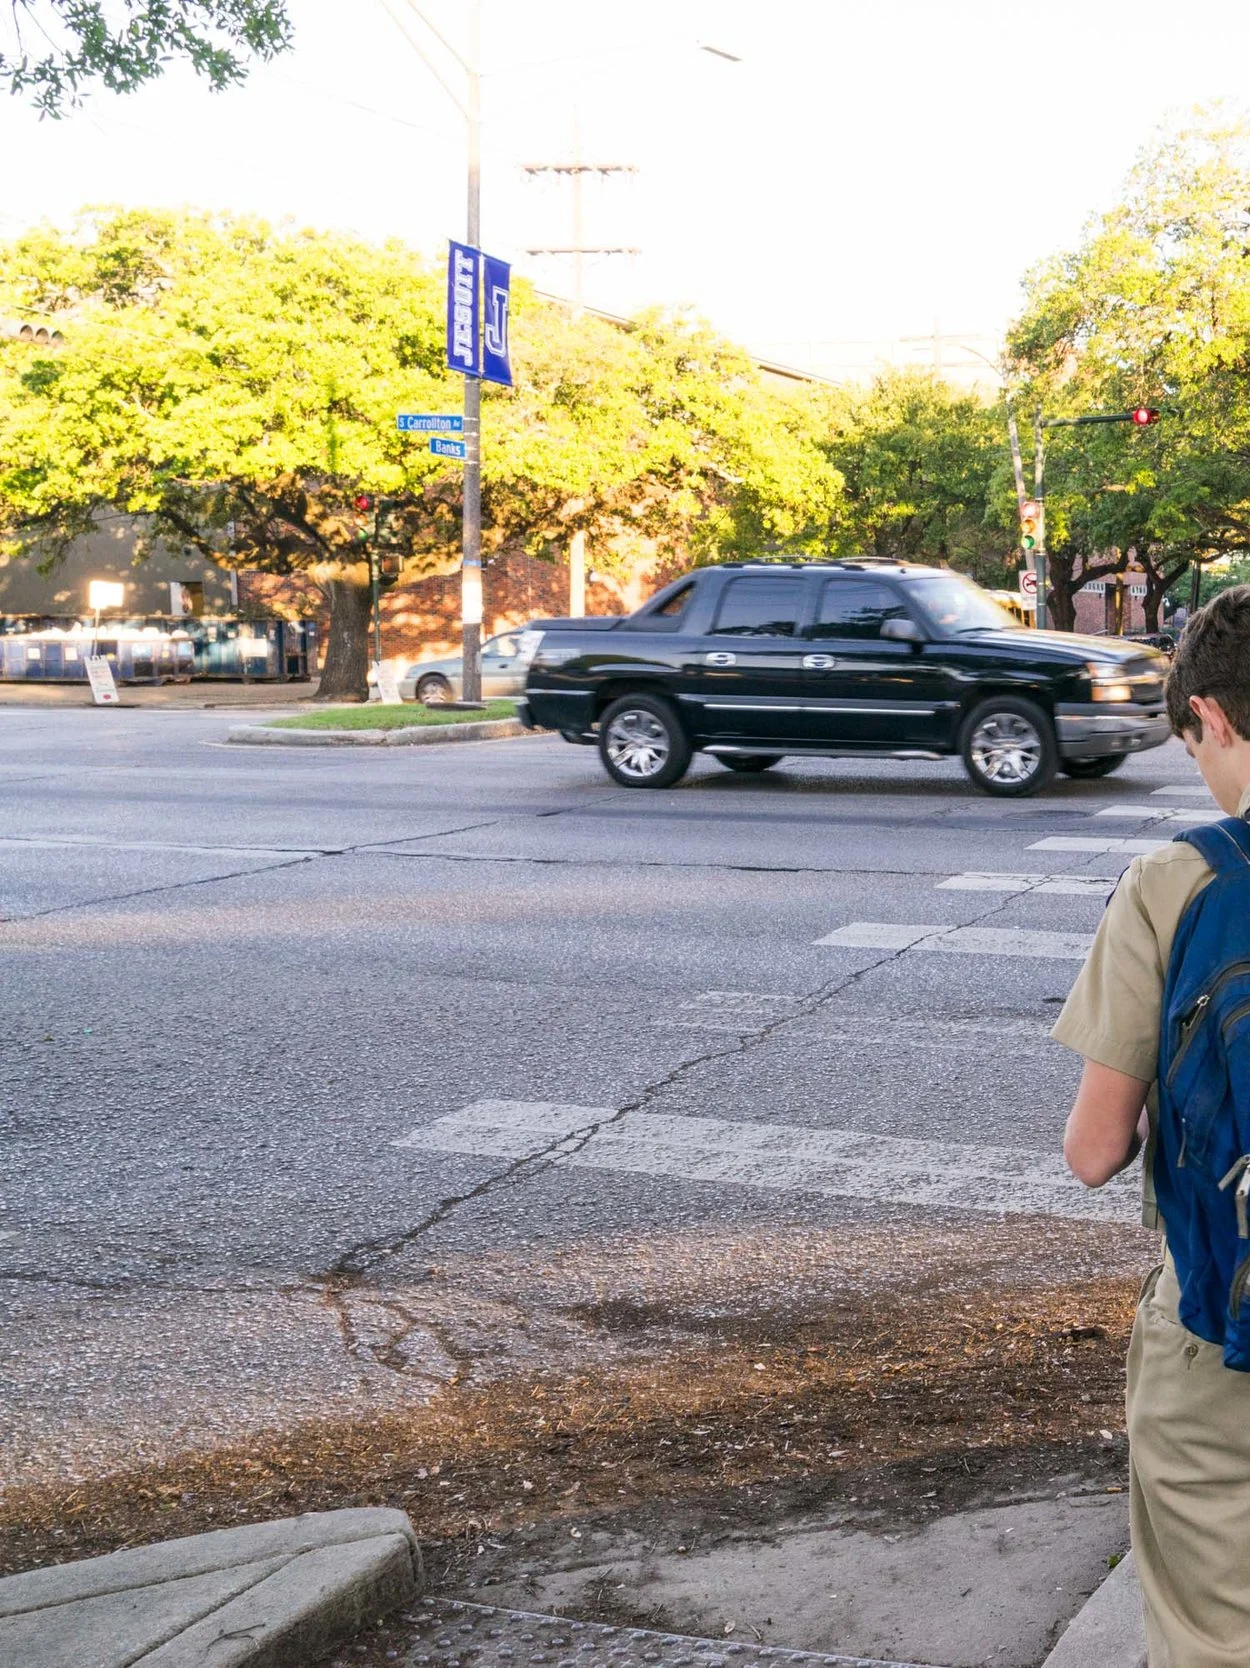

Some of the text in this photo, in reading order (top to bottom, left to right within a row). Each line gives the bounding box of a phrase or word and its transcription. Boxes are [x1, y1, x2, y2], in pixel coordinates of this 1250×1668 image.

[453, 249, 473, 366] JESUIT
[485, 285, 508, 357] J
[400, 417, 405, 428] S
[407, 416, 451, 429] Carrollton
[435, 440, 461, 455] Banks
